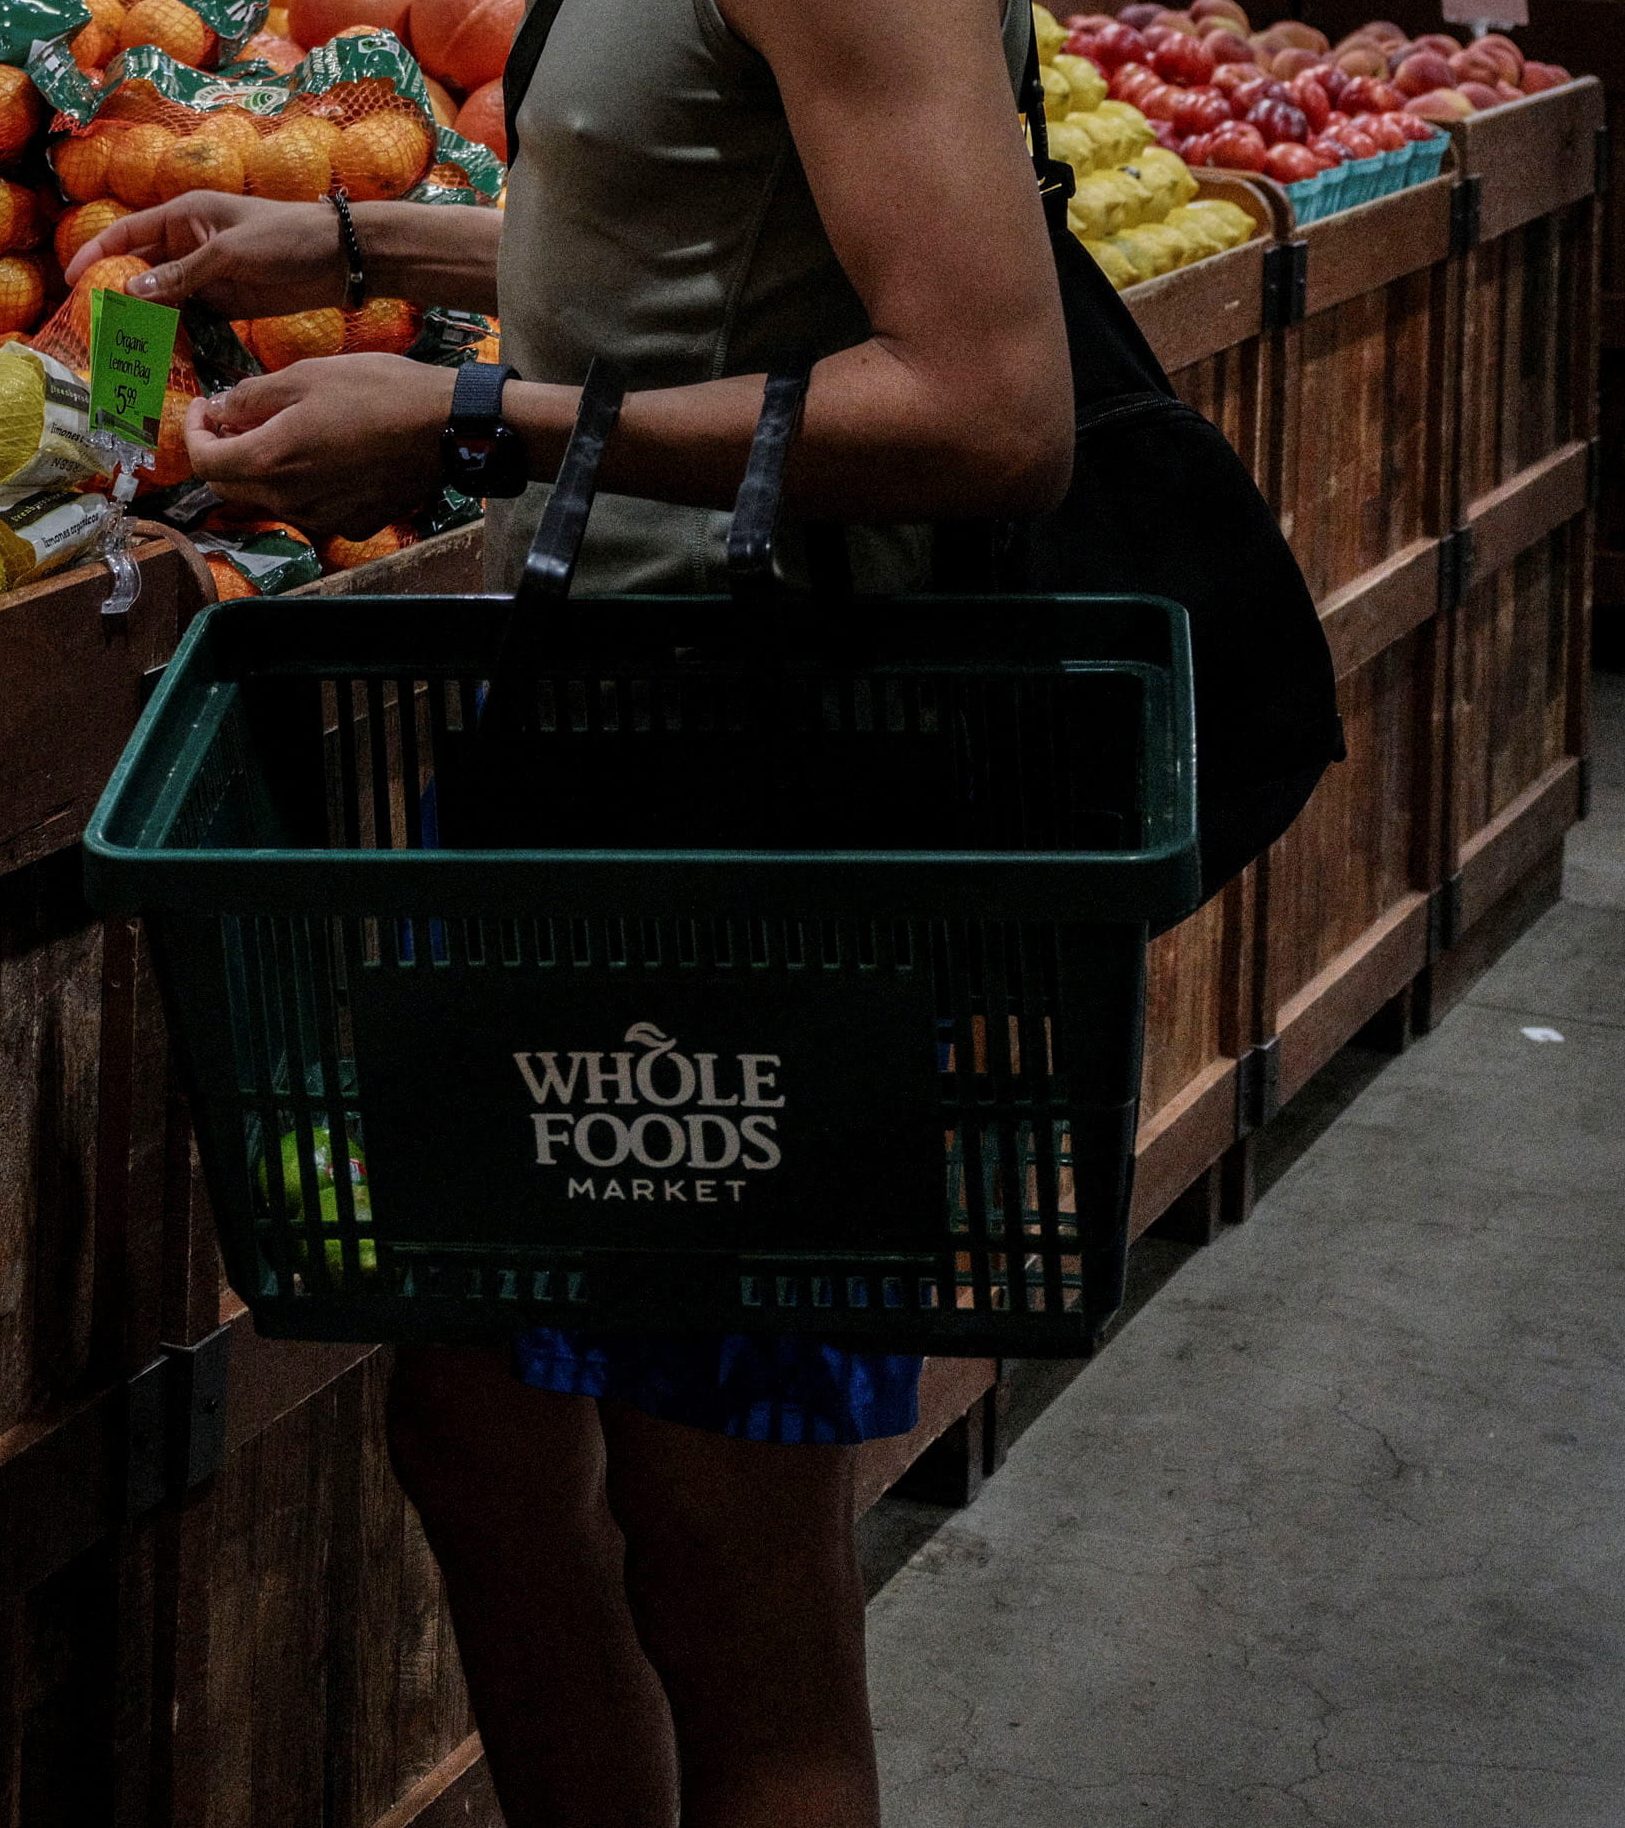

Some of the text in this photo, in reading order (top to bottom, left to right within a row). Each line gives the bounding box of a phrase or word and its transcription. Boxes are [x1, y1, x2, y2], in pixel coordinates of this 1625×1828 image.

[115, 328, 149, 354] Organic
[109, 356, 151, 385] Lemon Bag
[512, 1034, 786, 1108] WHOLE
[528, 1112, 783, 1170] FOODS
[567, 1176, 748, 1203] MARKET
